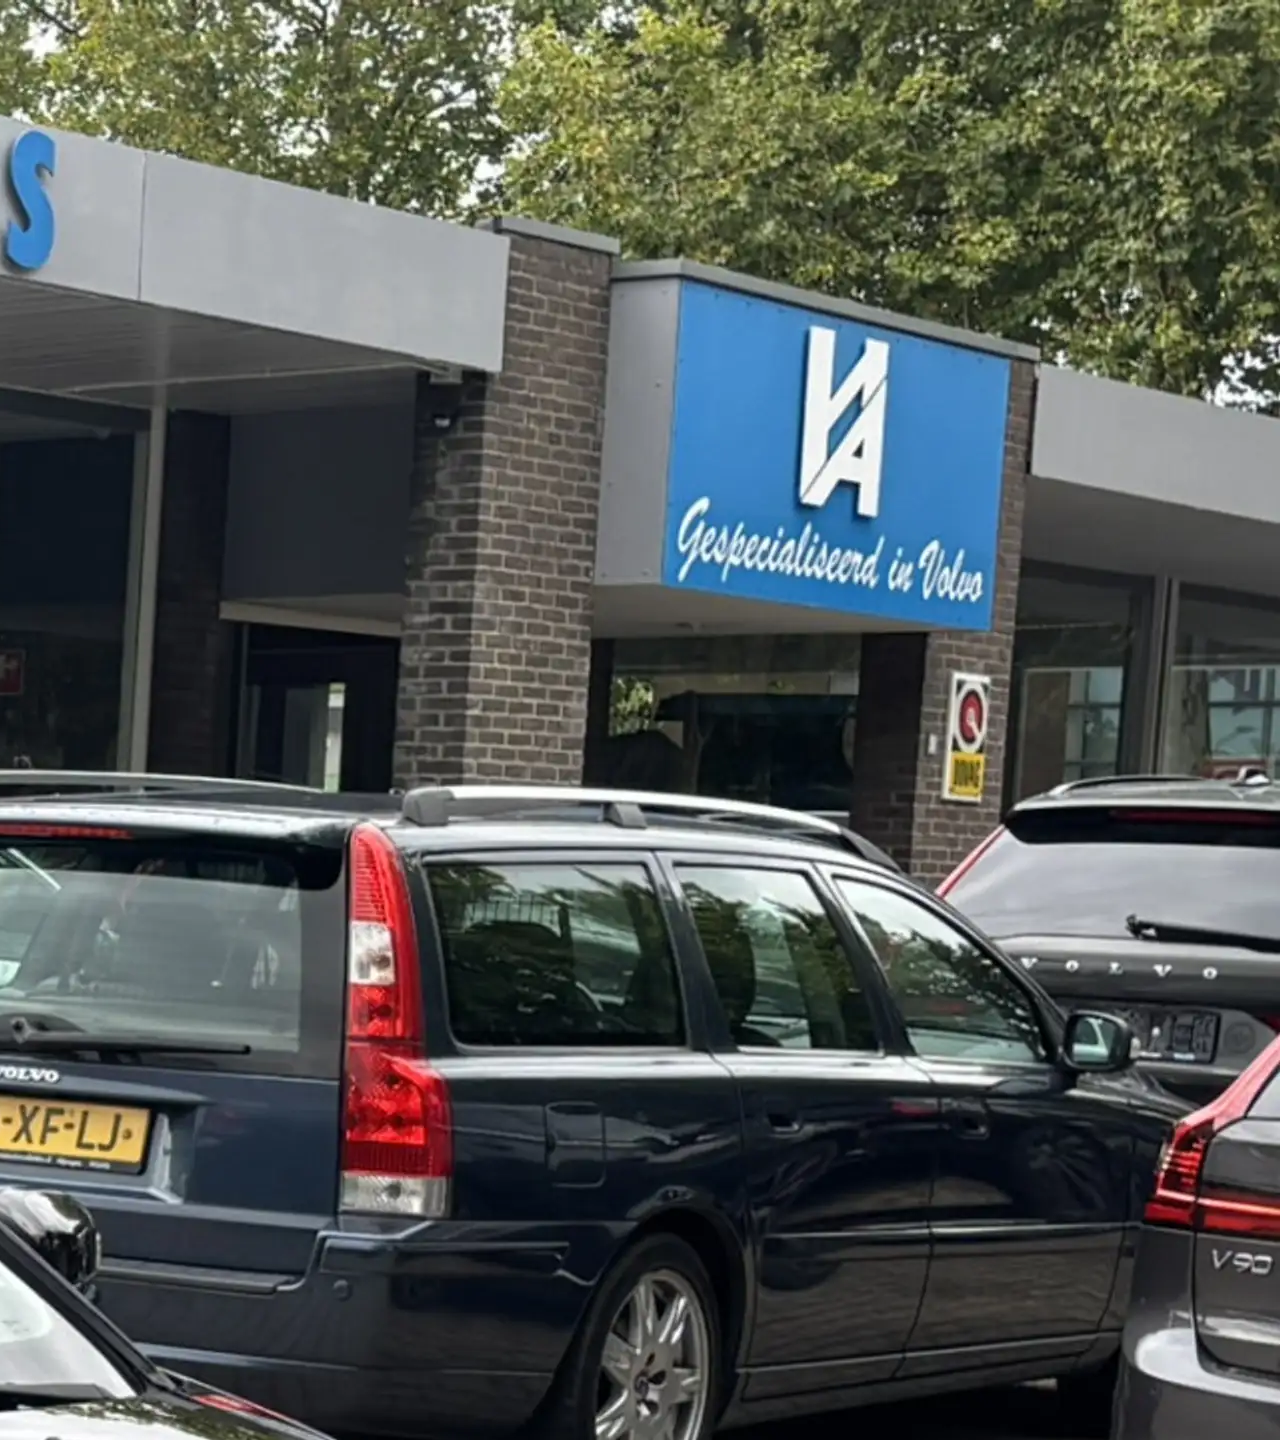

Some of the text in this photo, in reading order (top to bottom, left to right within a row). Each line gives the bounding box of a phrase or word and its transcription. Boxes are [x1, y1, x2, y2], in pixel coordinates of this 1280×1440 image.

[677, 496, 984, 602] Gespecialiseerd in Volvo
[1019, 956, 1219, 980] VOLVO
